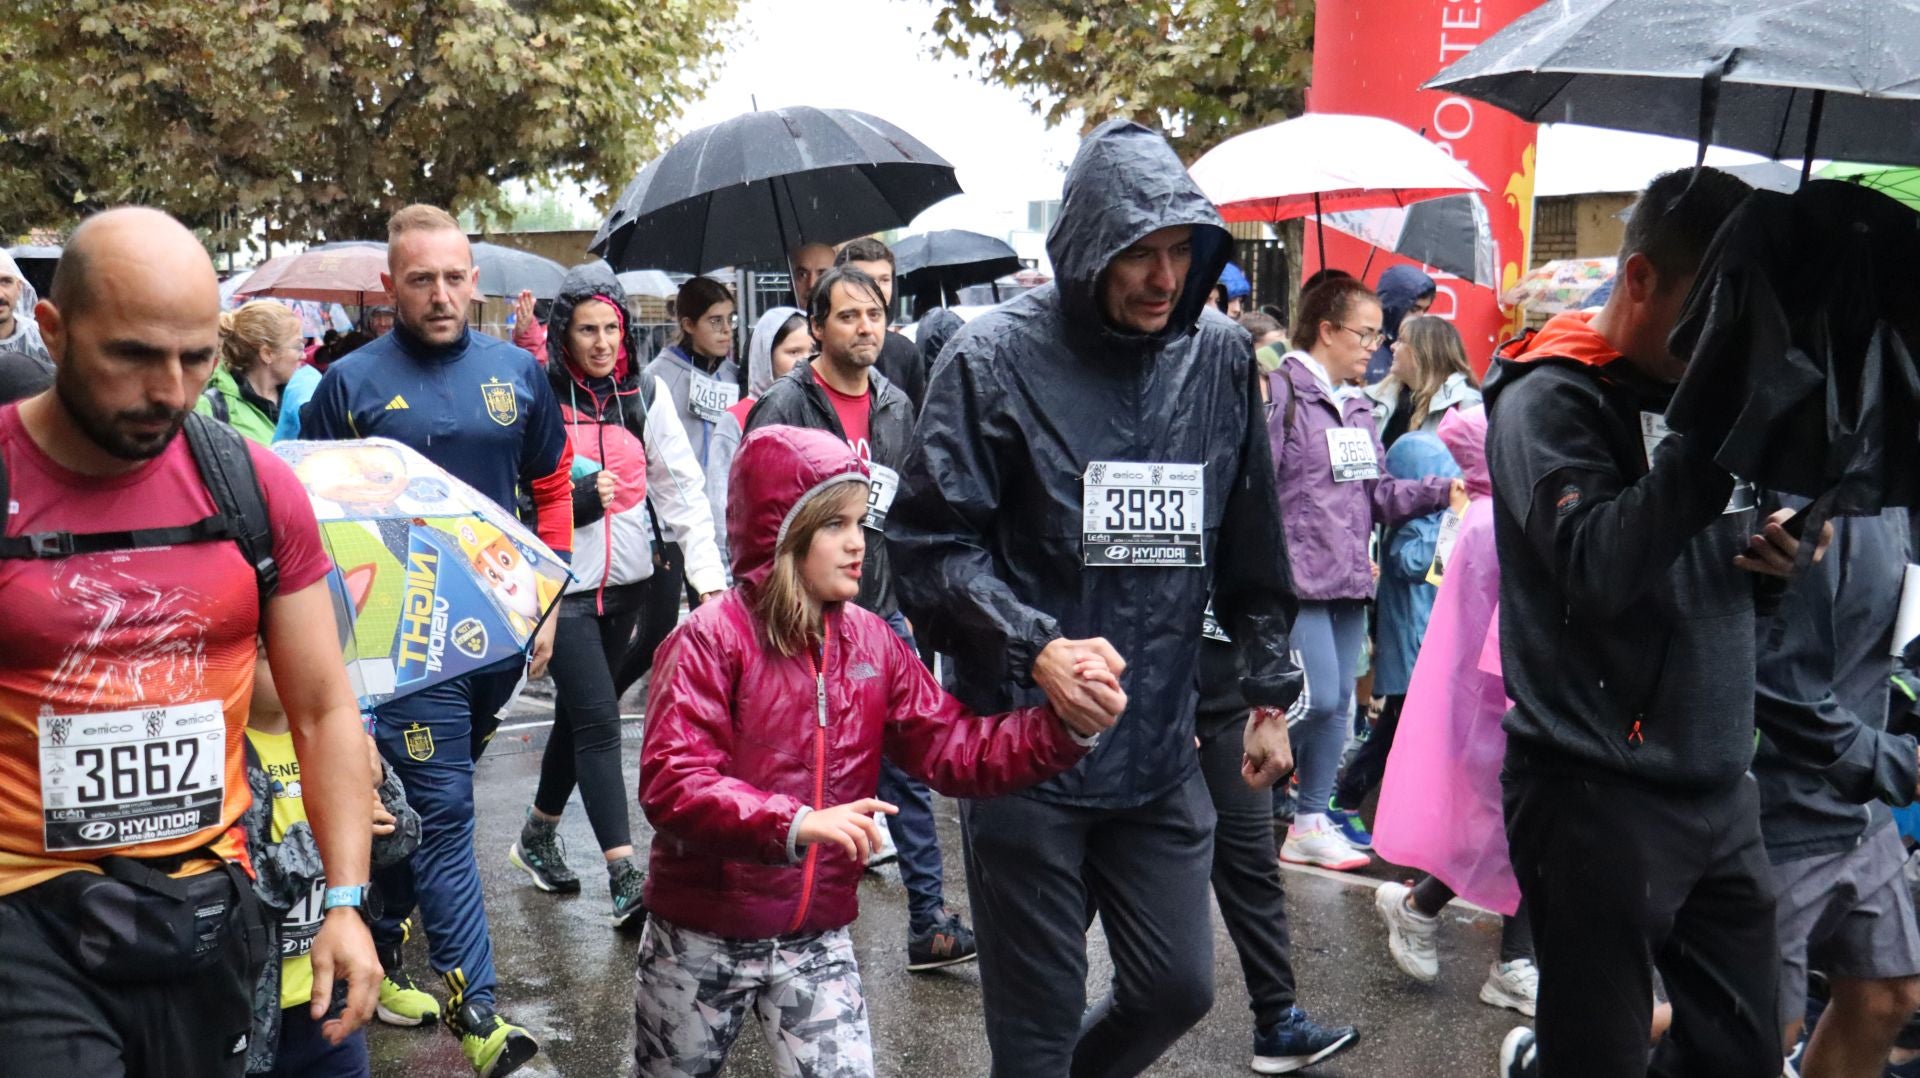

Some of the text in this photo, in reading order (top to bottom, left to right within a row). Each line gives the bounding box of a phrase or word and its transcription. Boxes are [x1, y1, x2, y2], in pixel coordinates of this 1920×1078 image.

[695, 384, 728, 411] 2498
[1106, 489, 1184, 531] 3933
[1132, 547, 1186, 558] HYUNDAI
[83, 722, 134, 736] emico
[176, 712, 215, 726] emico
[76, 738, 200, 803] 3662
[119, 810, 200, 835] HYUNDAI
